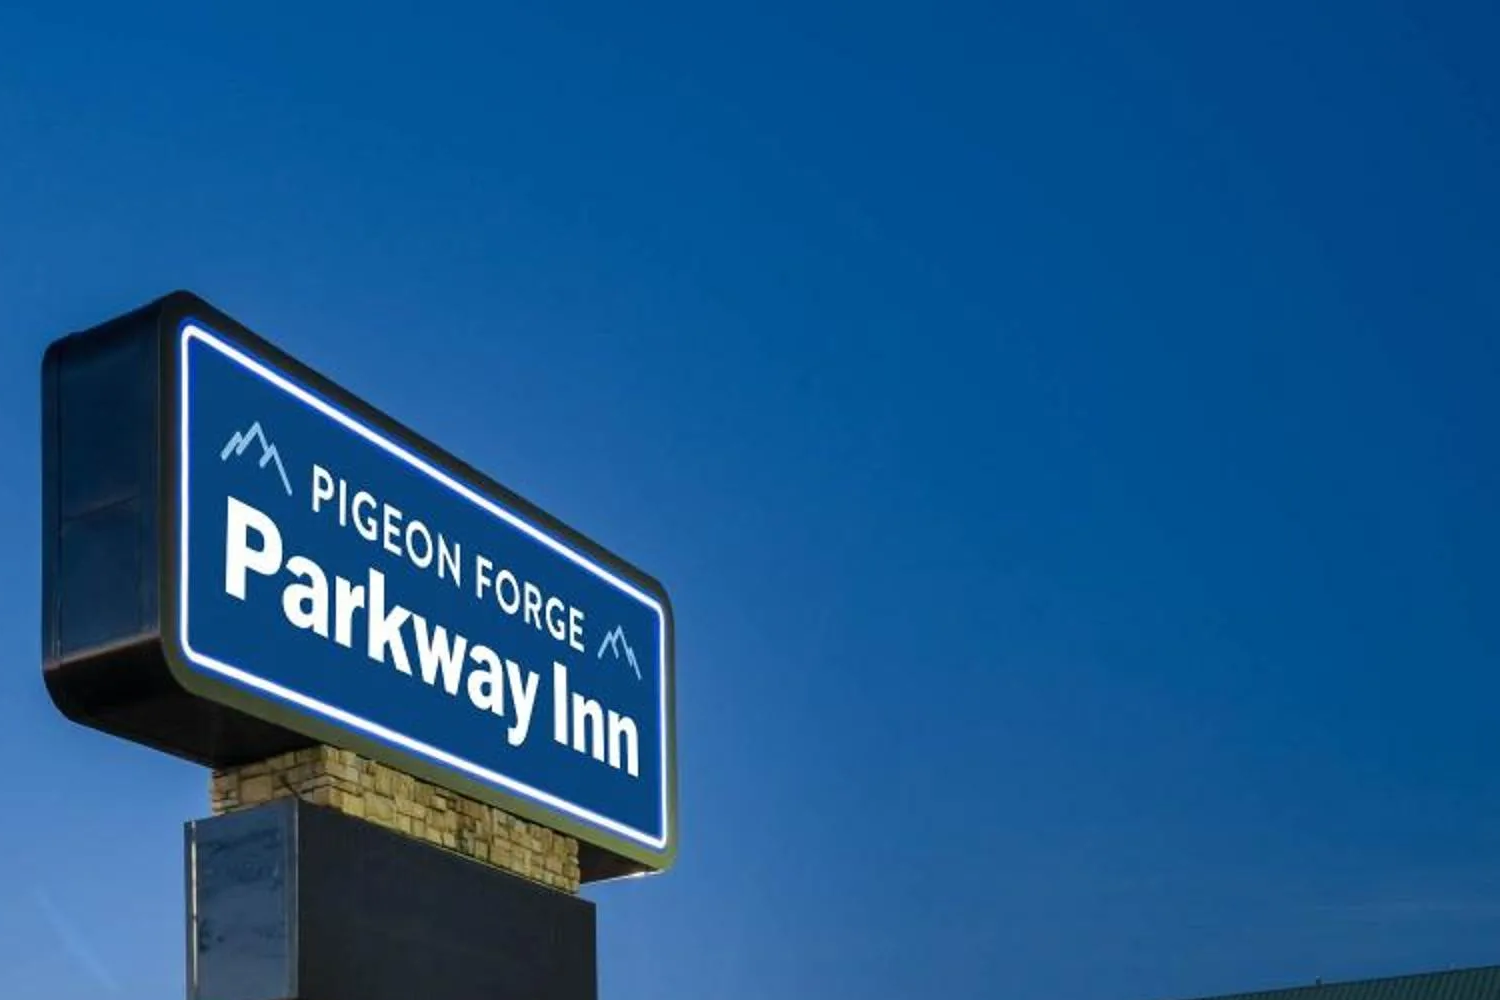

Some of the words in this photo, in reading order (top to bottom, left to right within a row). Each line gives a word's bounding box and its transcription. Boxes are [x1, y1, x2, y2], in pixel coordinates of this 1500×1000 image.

[224, 494, 541, 748] Parkway
[553, 660, 640, 778] Inn
[311, 463, 461, 588] PIGEON
[475, 554, 586, 653] FORGE
